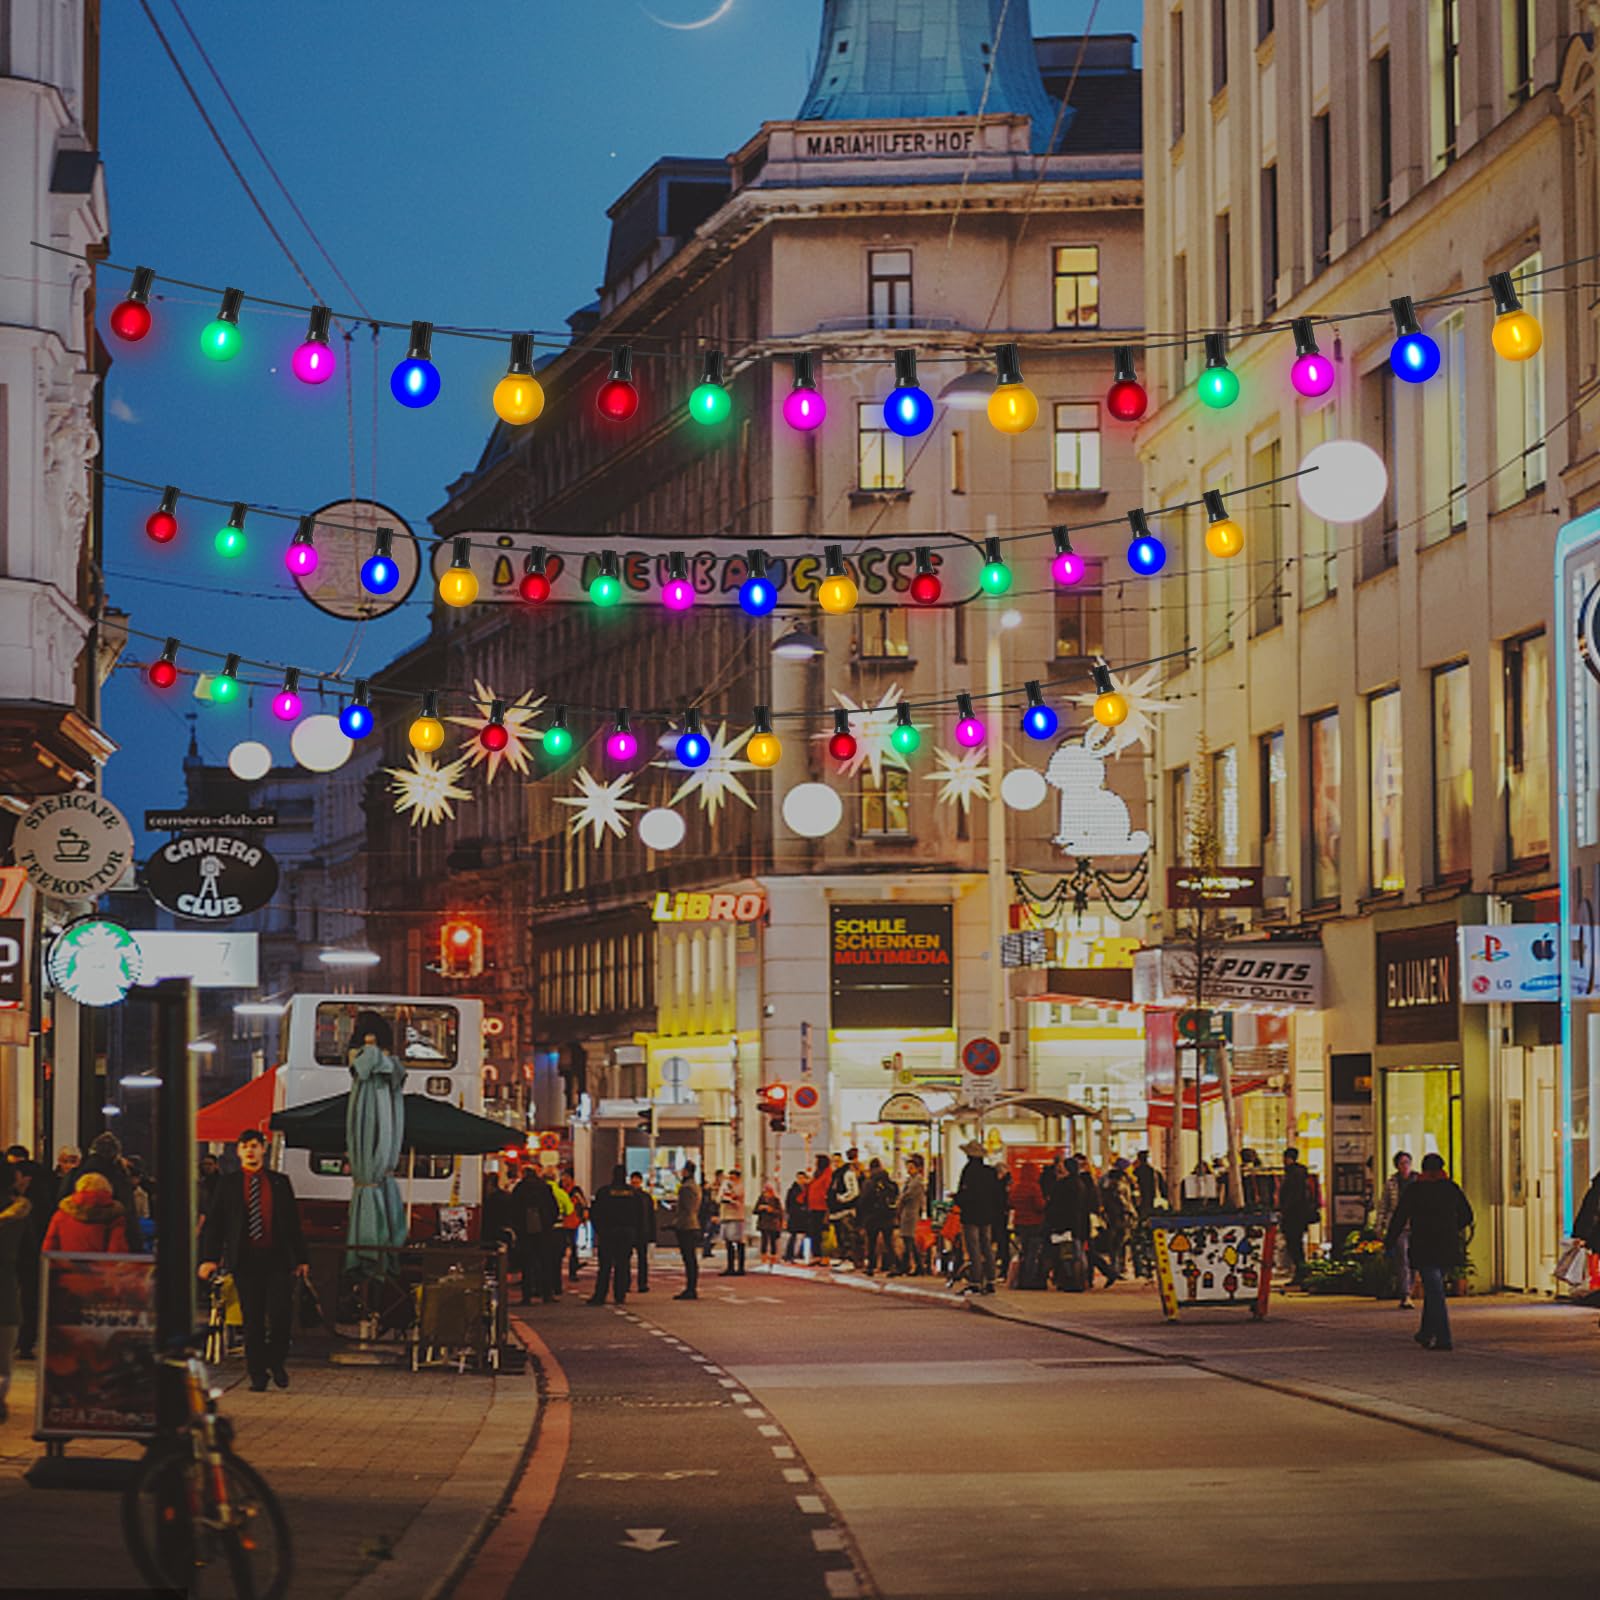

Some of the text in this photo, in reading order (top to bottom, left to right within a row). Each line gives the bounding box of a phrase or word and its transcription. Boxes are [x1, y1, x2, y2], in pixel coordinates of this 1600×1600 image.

[807, 131, 974, 156] MARIAHILFER-HOF
[148, 813, 275, 827] camera-club.at
[163, 836, 263, 867] CAMERA
[20, 849, 124, 895] TEEKONTOR
[177, 893, 243, 917] CLUB
[834, 918, 907, 934] SCHULE
[834, 934, 941, 950] SCHENKEN
[834, 949, 951, 965] MULTIMEDIA
[1200, 957, 1311, 981] SPORTS
[1387, 955, 1450, 1008] BLUMEN
[1496, 979, 1513, 990] LG
